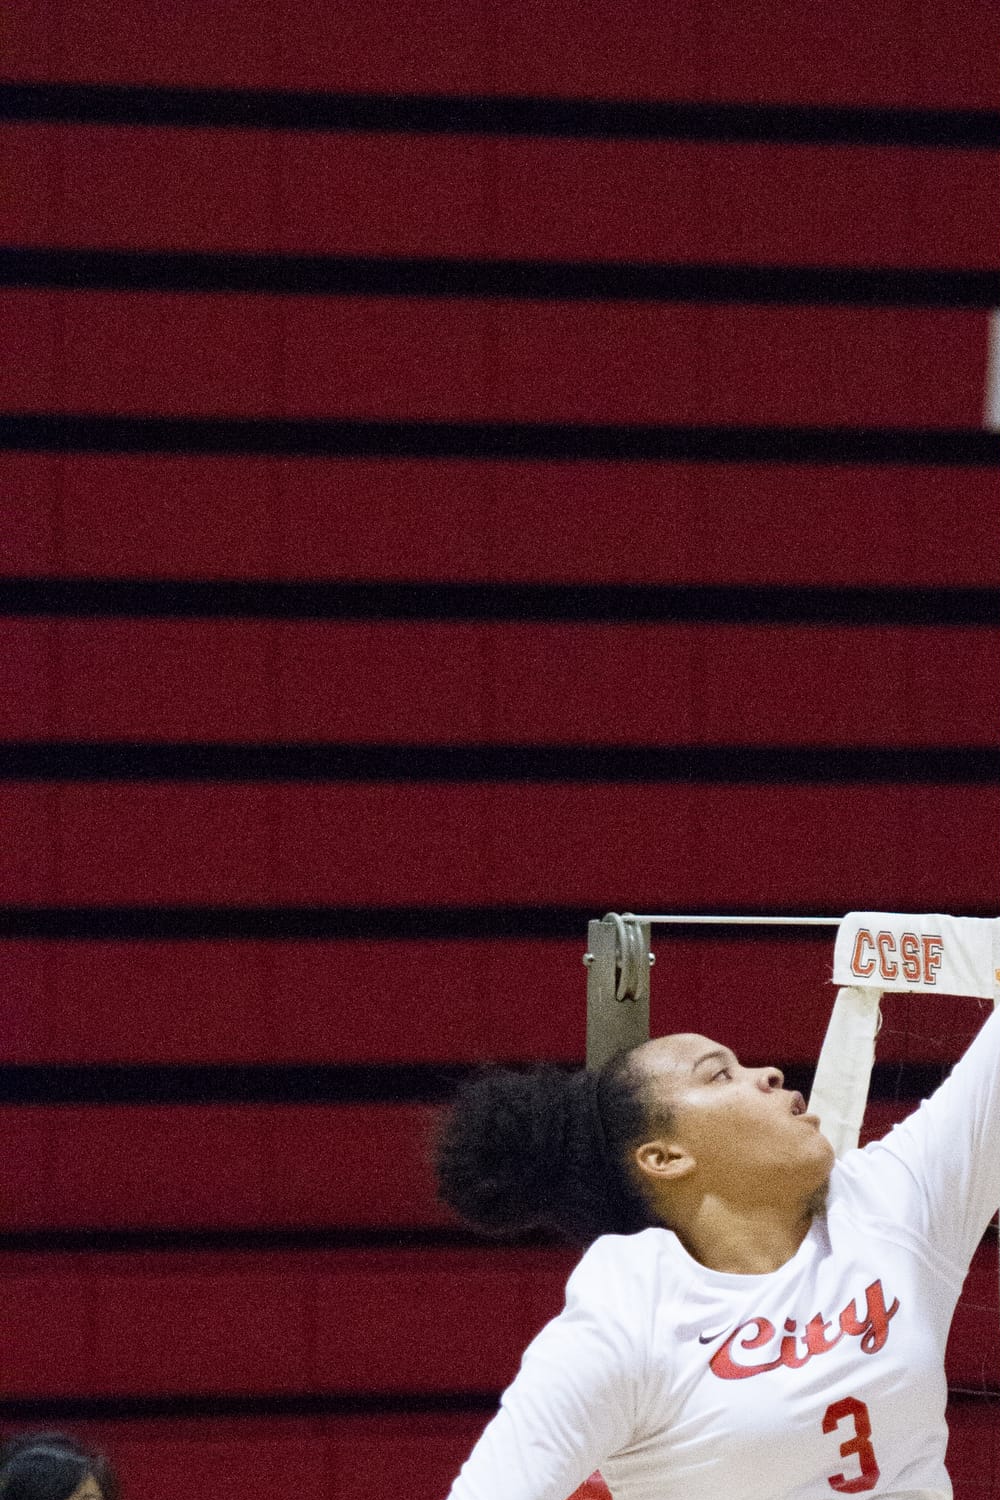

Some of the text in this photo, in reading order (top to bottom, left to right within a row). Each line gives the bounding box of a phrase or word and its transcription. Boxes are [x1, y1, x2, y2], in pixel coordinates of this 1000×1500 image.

[850, 928, 944, 985] CCSF
[709, 1279, 900, 1380] City
[822, 1396, 881, 1494] 3
